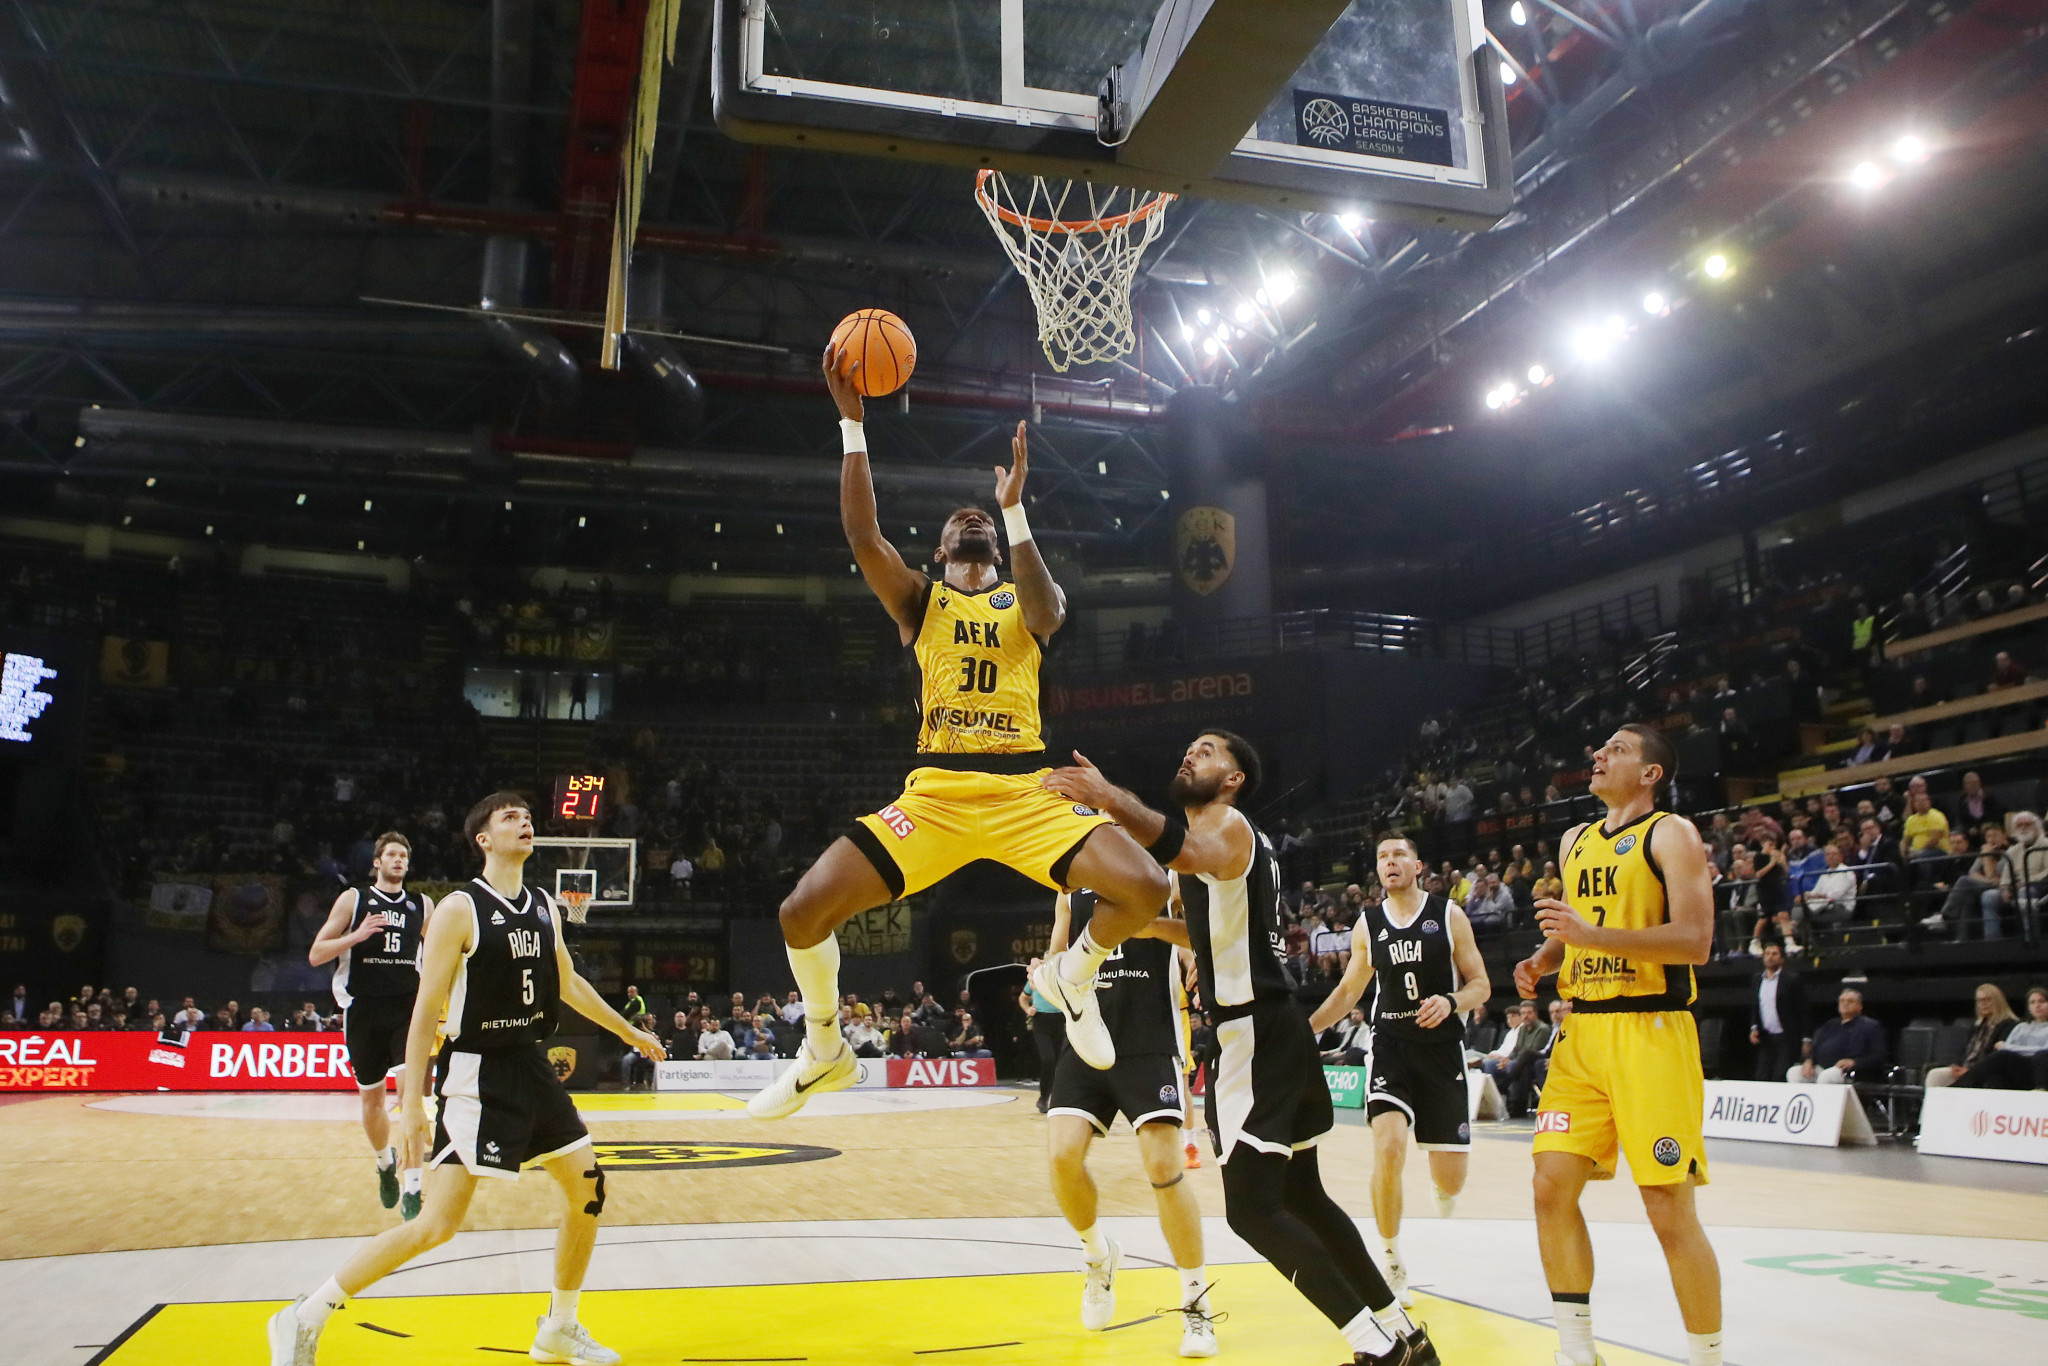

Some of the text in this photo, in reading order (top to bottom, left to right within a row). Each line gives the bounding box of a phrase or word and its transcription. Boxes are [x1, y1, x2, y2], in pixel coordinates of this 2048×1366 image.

[1352, 103, 1433, 123] BASKETBALL
[1352, 114, 1444, 137] CHAMPIONS
[1353, 127, 1404, 142] LEAGUE
[1355, 140, 1395, 153] SEASON
[953, 619, 1001, 648] AEK
[957, 656, 998, 694] 30
[1074, 673, 1252, 710] SUNEL arena
[947, 709, 1021, 732] SUNEL
[568, 774, 605, 792] 6:34
[561, 791, 600, 816] 21
[1577, 865, 1619, 898] AEK
[382, 931, 402, 953] 15
[507, 928, 541, 960] RĪGA
[1388, 939, 1423, 966] RĪGA
[1118, 969, 1150, 979] BANKA
[1404, 971, 1420, 1001] 9
[522, 968, 535, 1006] 5
[481, 1017, 529, 1030] RIETUMU
[0, 1067, 95, 1087] EXPERT
[905, 1060, 979, 1086] AVIS
[1709, 1095, 1780, 1125] Allianz
